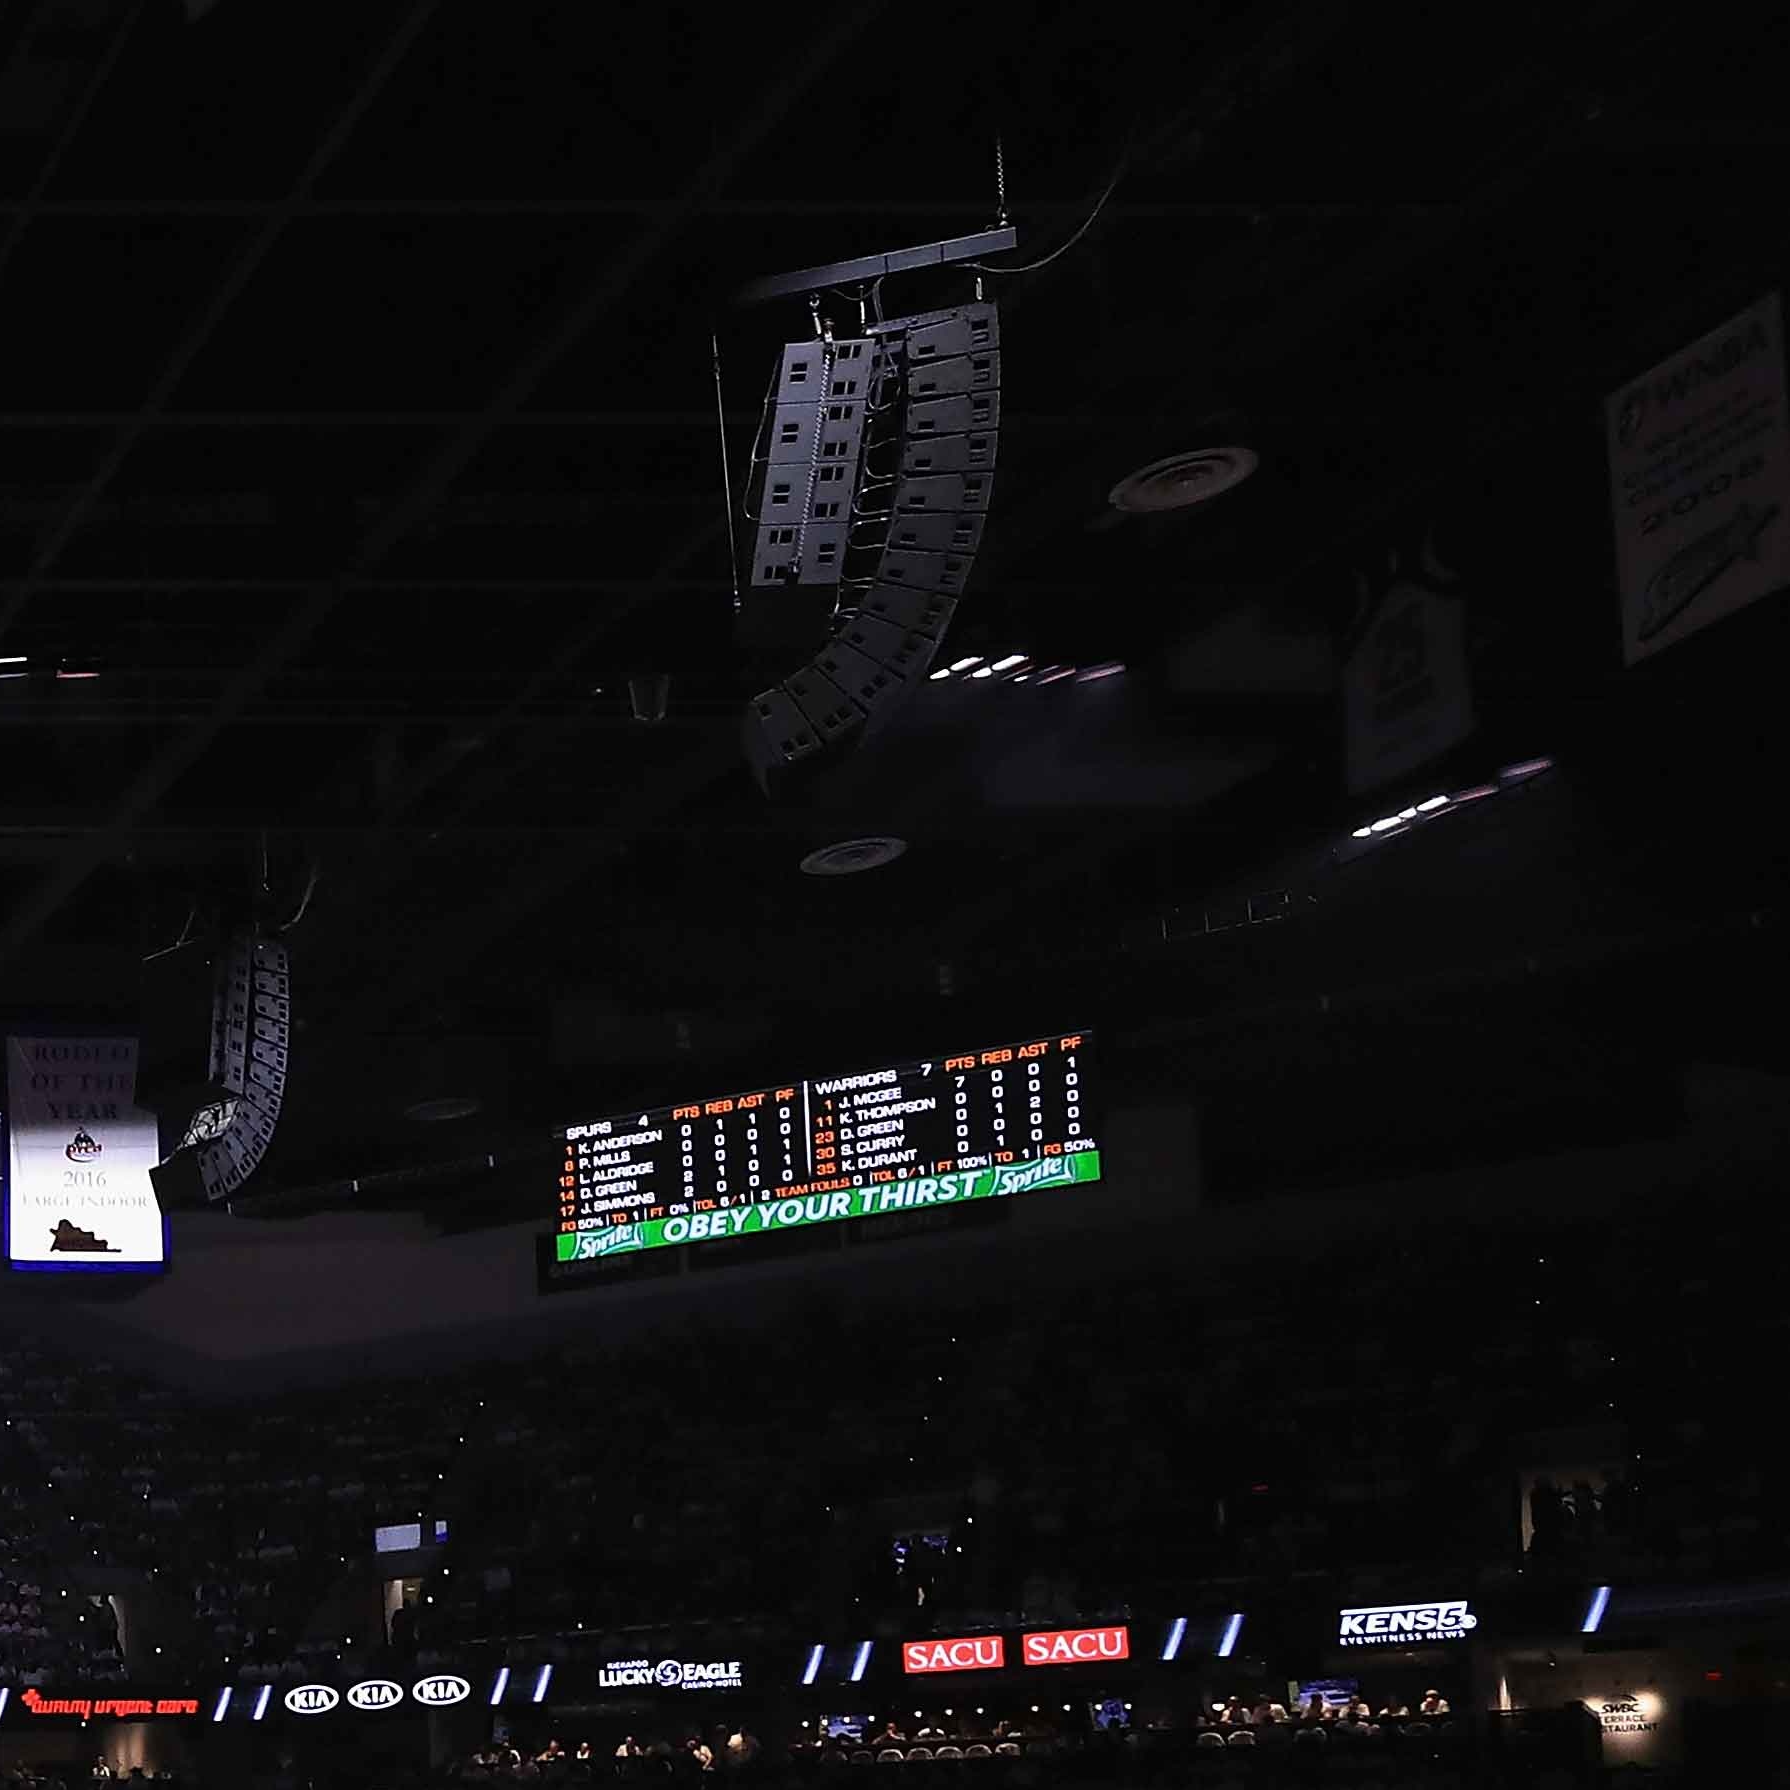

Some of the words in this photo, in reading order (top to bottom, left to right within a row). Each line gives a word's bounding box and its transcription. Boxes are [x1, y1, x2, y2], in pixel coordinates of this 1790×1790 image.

[815, 1070, 897, 1095] WARRIORS
[566, 1121, 612, 1138] SPURS
[63, 1170, 107, 1188] 2016
[661, 1204, 758, 1241] OBEY
[758, 1190, 850, 1228] YOUR
[859, 1171, 977, 1213] THIRST
[1340, 1608, 1439, 1636] KENS
[1028, 1631, 1122, 1660] SACU
[1426, 1630, 1466, 1640] NEWS
[907, 1639, 998, 1670] SACU
[598, 1667, 656, 1687] LUCKY
[682, 1661, 742, 1681] EAGLE
[293, 1690, 331, 1708] KIA
[356, 1685, 395, 1705] KIA
[421, 1681, 461, 1701] KIA
